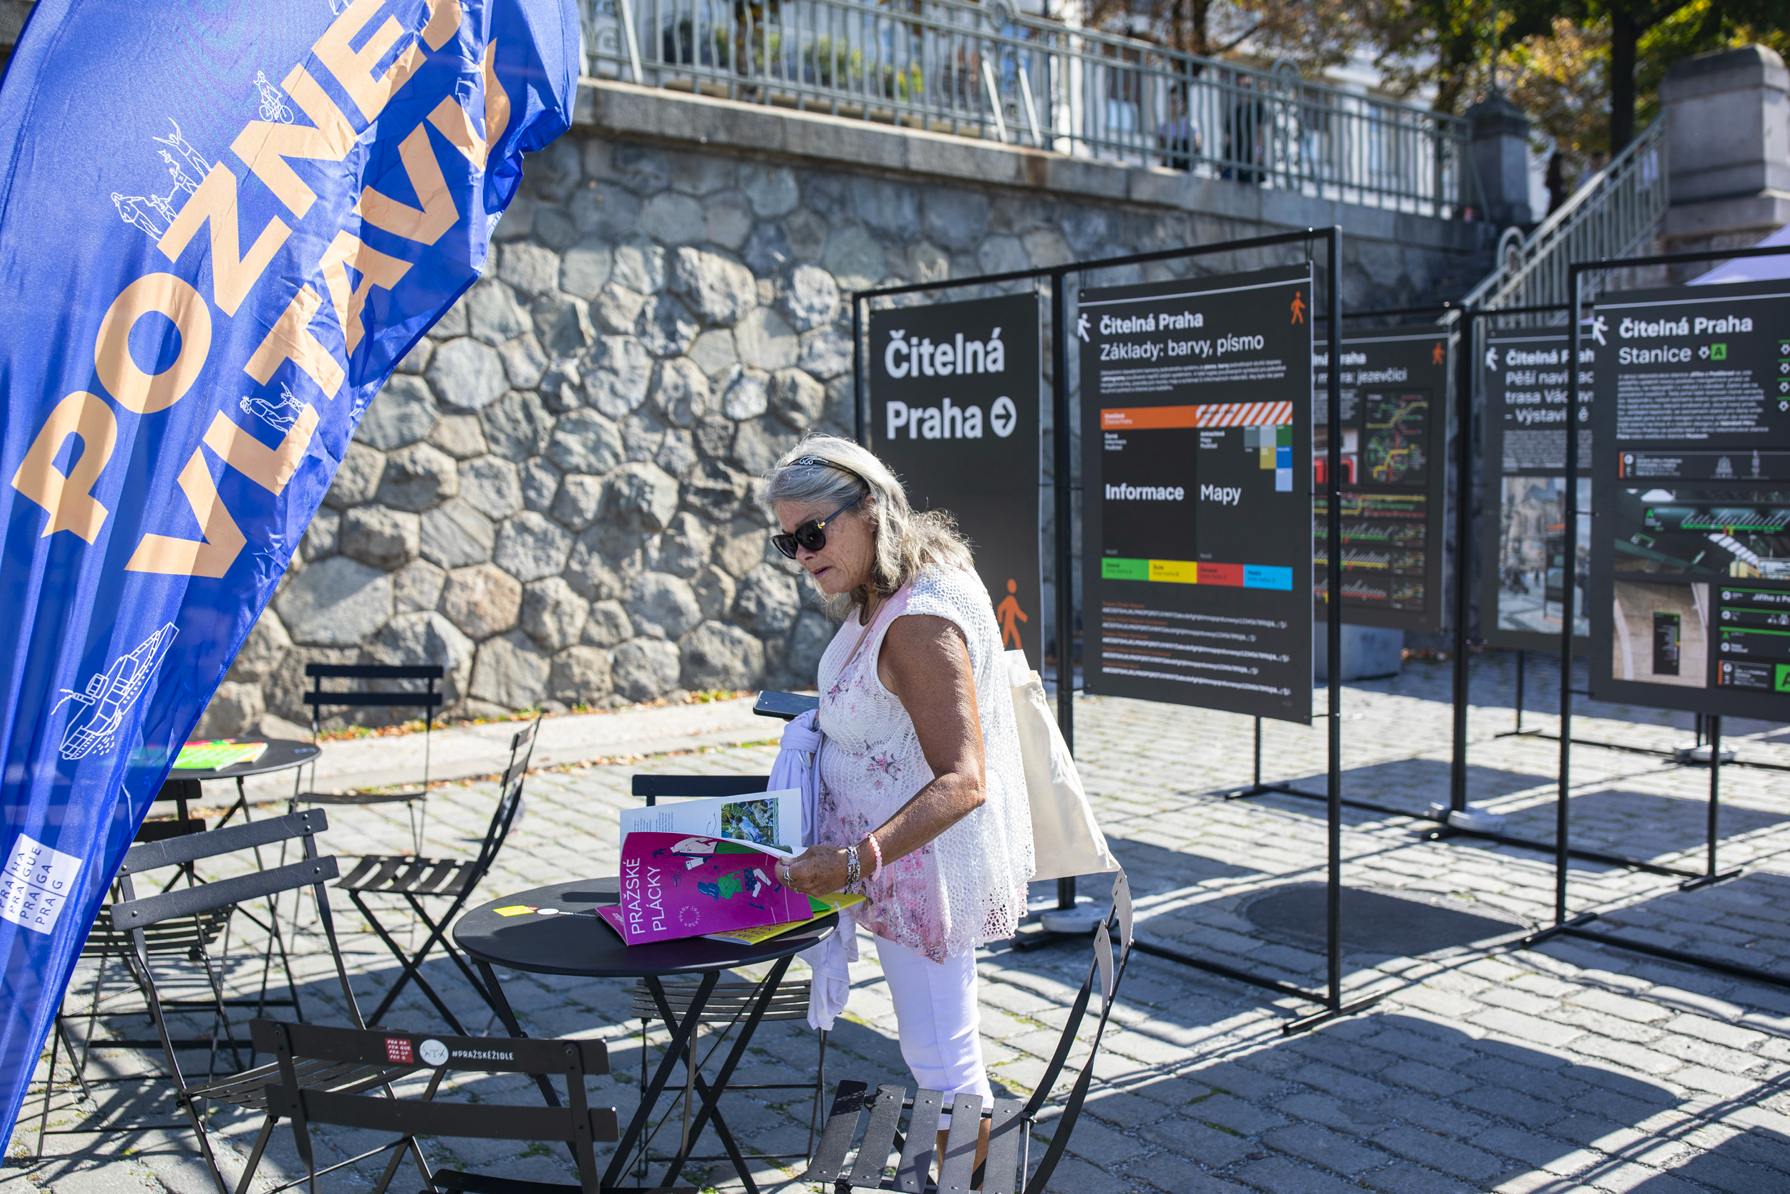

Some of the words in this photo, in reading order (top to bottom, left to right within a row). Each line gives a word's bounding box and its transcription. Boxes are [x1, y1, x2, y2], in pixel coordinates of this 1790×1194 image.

[1100, 313, 1155, 335] Čitelná
[1159, 311, 1203, 330] Praha
[1619, 317, 1690, 339] Čitelná
[1694, 315, 1753, 335] Praha
[884, 326, 1005, 379] Čitelná
[1100, 341, 1164, 361] Základy:
[1168, 339, 1213, 358] barvy,
[1217, 333, 1264, 355] písmo
[1618, 346, 1692, 365] Stanice
[886, 397, 983, 440] Praha
[1105, 483, 1185, 500] Informace
[1200, 484, 1242, 506] Mapy
[22, 847, 42, 877] GUE
[20, 892, 40, 920] PRA
[36, 865, 53, 884] GA
[35, 898, 56, 925] PRA
[52, 879, 63, 890] G
[623, 857, 646, 935] PRAŽSKÉ
[645, 866, 667, 932] PLÁCKY
